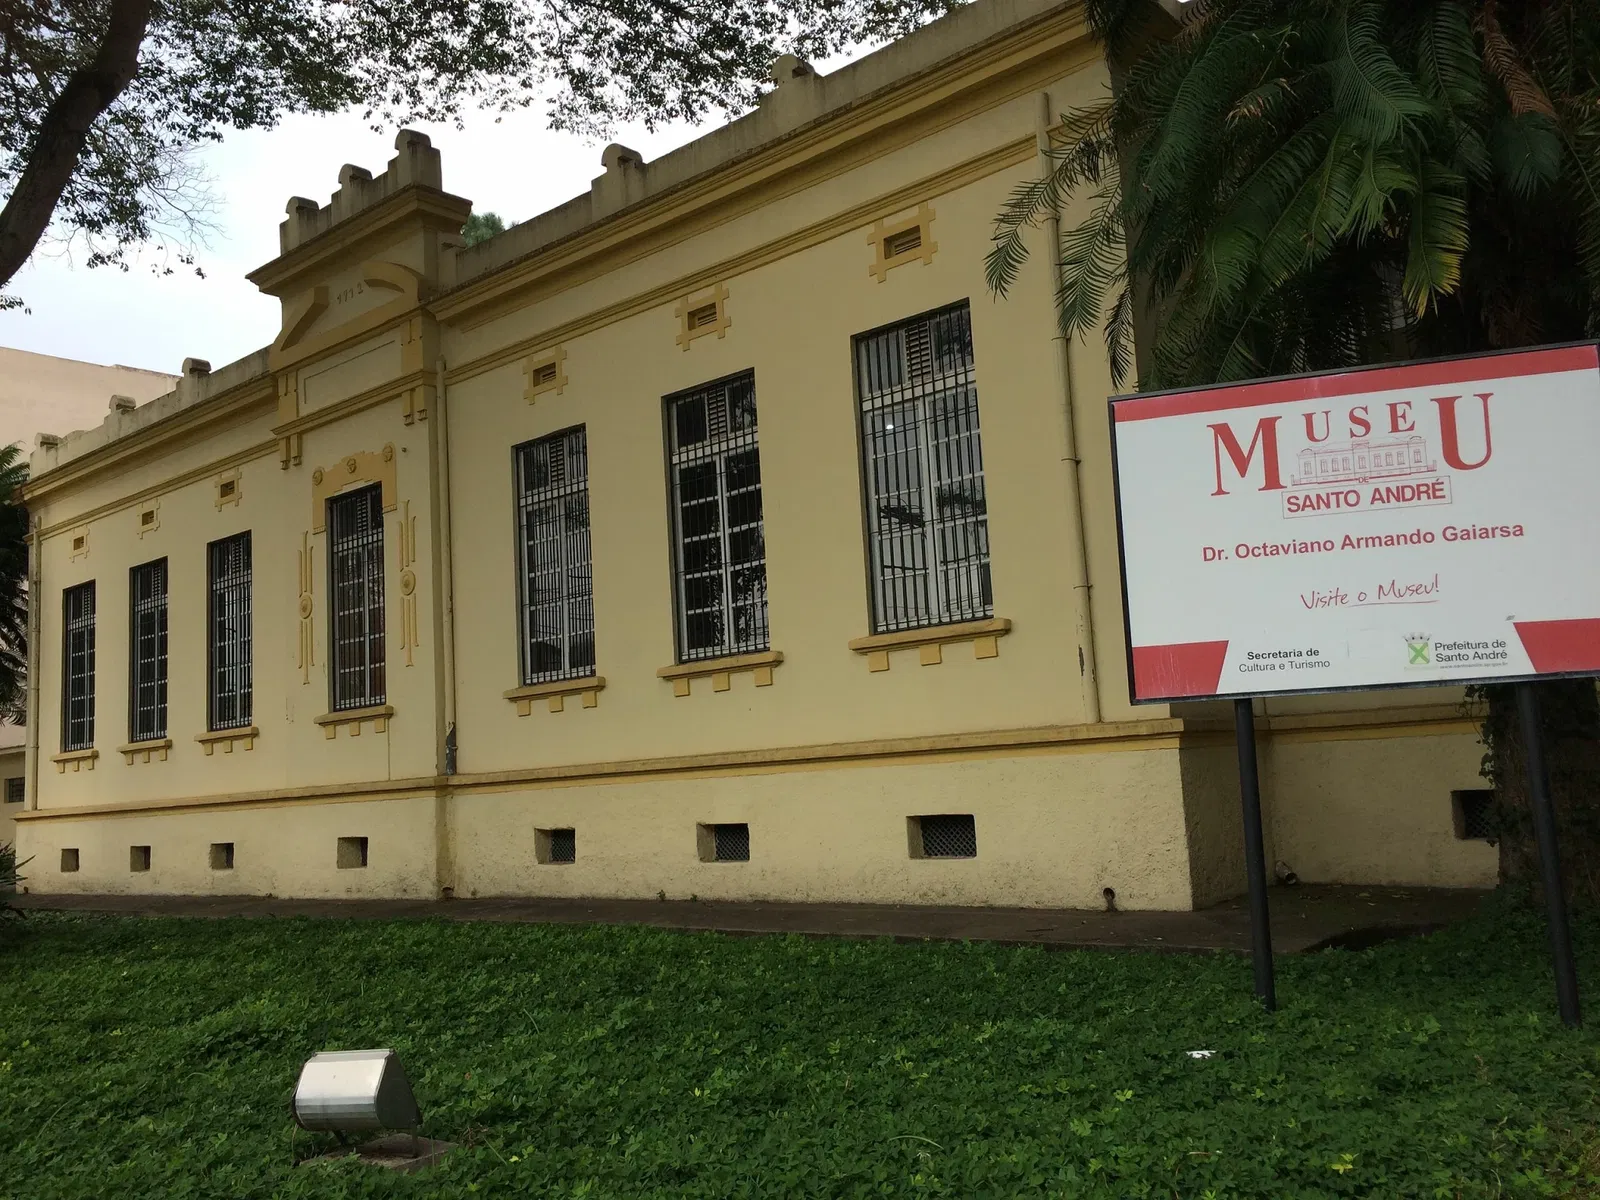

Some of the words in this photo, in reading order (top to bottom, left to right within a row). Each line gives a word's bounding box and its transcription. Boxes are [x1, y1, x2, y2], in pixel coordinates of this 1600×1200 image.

[1207, 392, 1494, 496] MUSEU
[1286, 488, 1361, 513] SANTO
[1370, 478, 1446, 505] ANDRÉ
[1203, 546, 1229, 562] Dr.
[1235, 537, 1335, 560] Octaviano
[1340, 528, 1435, 551] Armando
[1442, 523, 1525, 542] Gaiarsa
[1300, 586, 1350, 610] Visite
[1356, 591, 1368, 602] o
[1377, 573, 1440, 600] Museu!
[1247, 648, 1303, 661] Secretaria
[1305, 647, 1320, 658] de
[1434, 640, 1489, 652] Prefeitura
[1491, 639, 1507, 649] de
[1435, 651, 1470, 663] Santo
[1472, 649, 1508, 661] André
[1238, 662, 1276, 673] Cultura
[1278, 662, 1286, 671] e
[1288, 659, 1331, 670] Turismo
